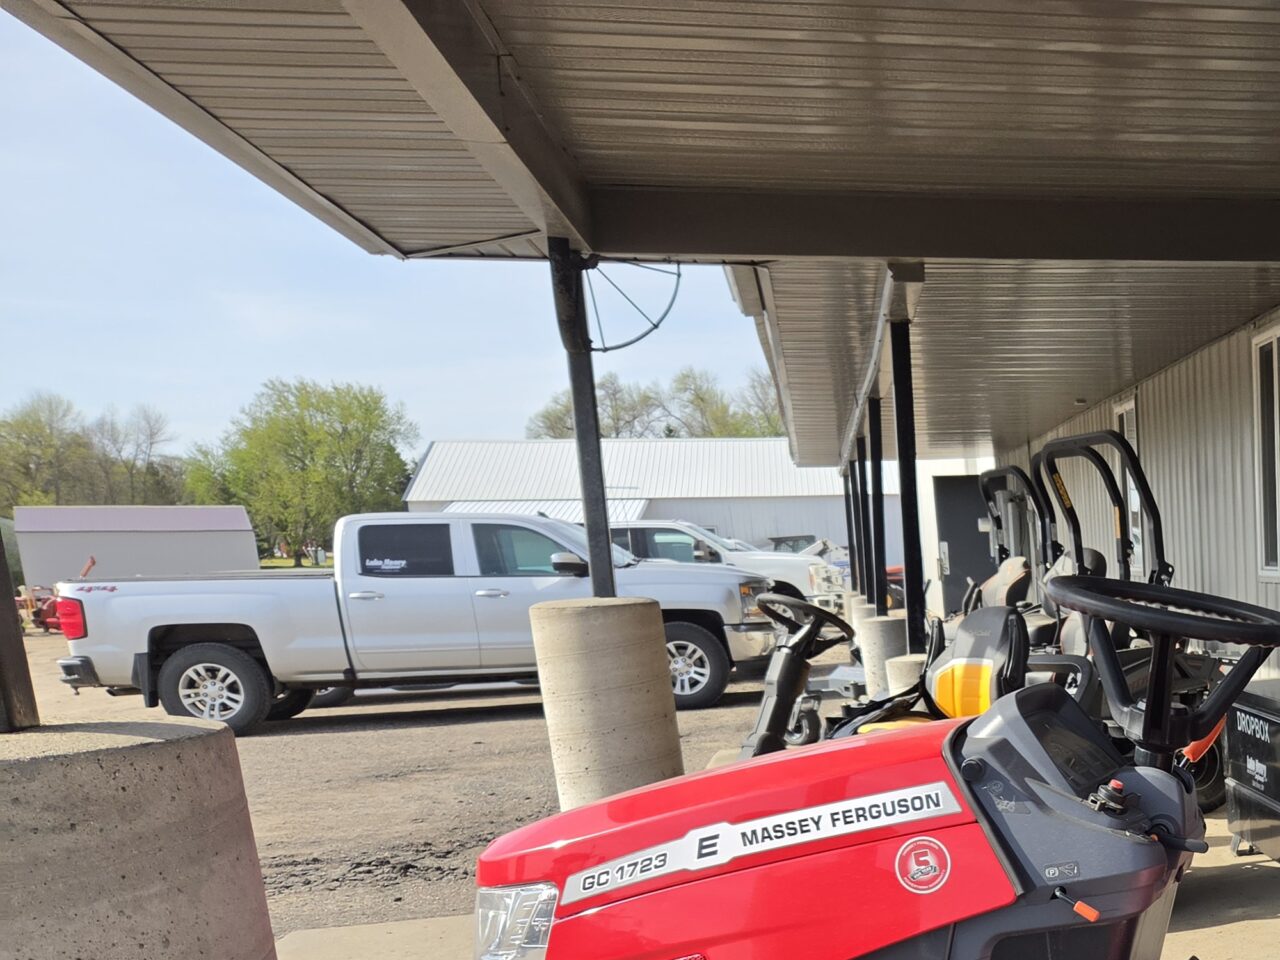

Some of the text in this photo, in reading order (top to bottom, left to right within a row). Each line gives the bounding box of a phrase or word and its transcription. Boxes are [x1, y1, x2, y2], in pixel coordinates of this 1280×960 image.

[1236, 710, 1271, 744] DROPBOX
[740, 792, 942, 847] MASSEY FERGUSON
[696, 833, 721, 860] E
[911, 848, 931, 868] 5
[582, 852, 668, 891] GC 1723
